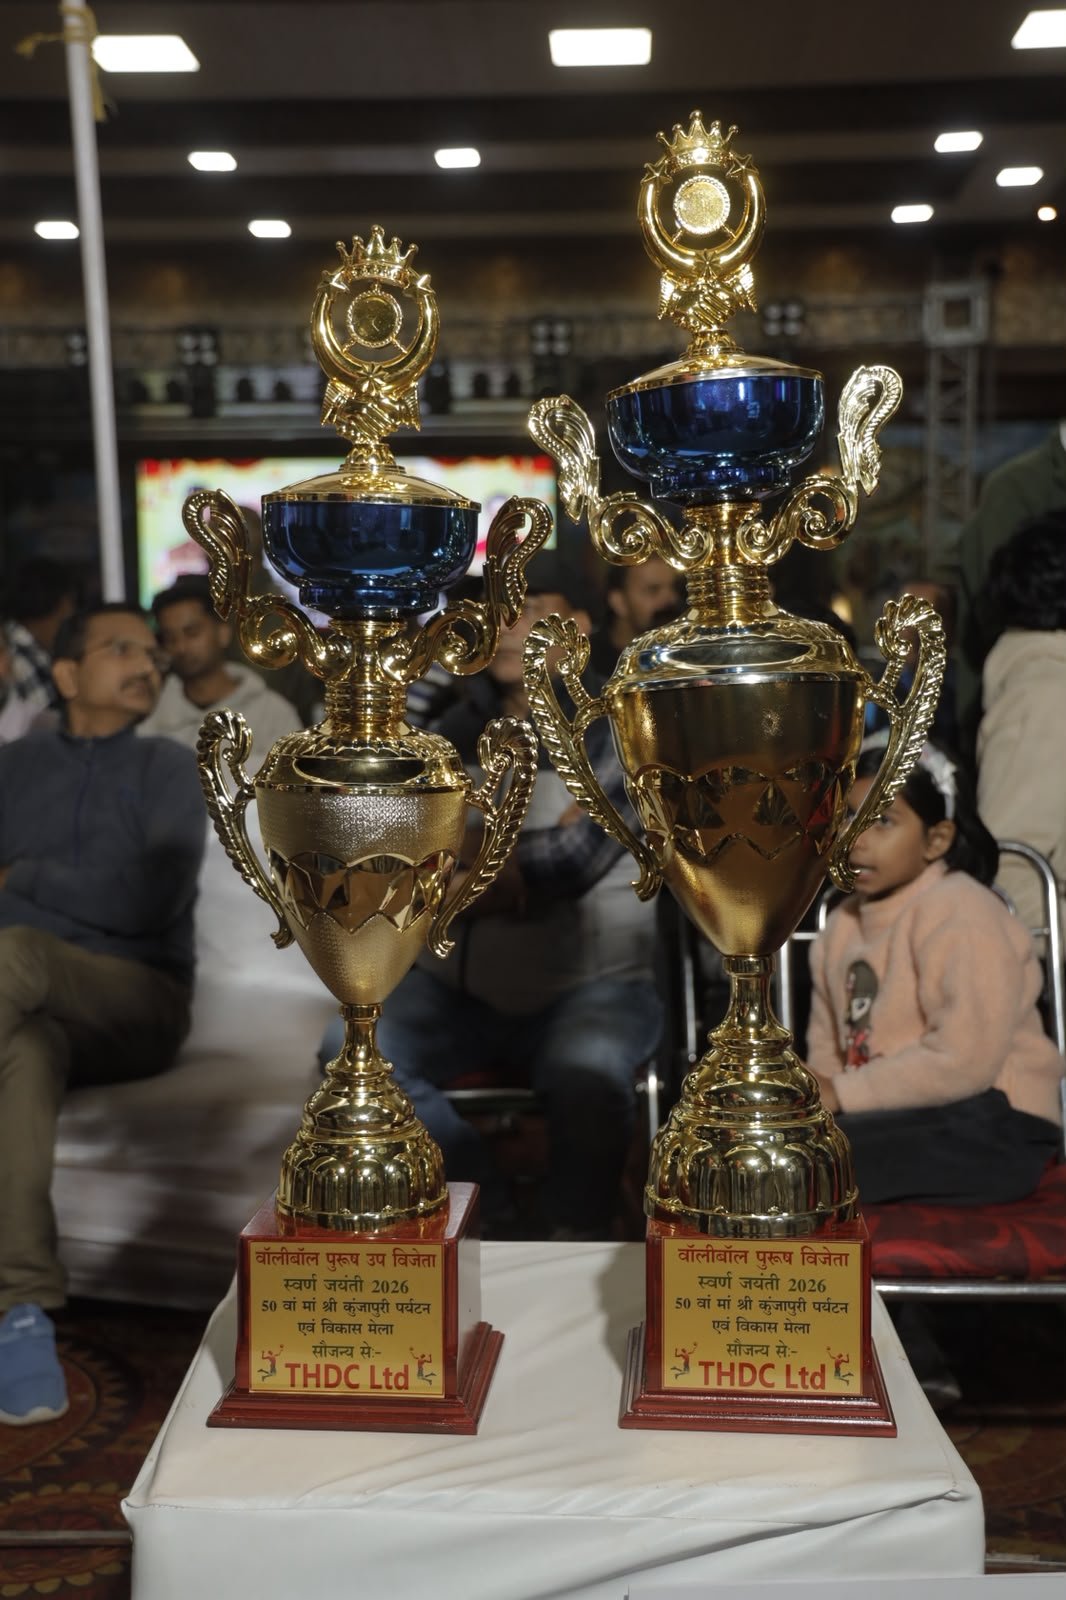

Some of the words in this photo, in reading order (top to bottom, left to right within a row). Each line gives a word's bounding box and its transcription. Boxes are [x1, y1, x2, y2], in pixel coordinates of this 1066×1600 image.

[255, 1248, 319, 1266] वॉलीबॉल
[367, 1253, 386, 1267] उप
[392, 1249, 436, 1268] विजेता
[678, 1245, 749, 1264] वॉलीबॉल
[801, 1246, 849, 1267] विजेता
[284, 1274, 316, 1292] स्वर्ण
[324, 1275, 363, 1292] जयंती
[372, 1280, 409, 1293] 2026
[698, 1272, 731, 1289] स्वर्ण
[739, 1273, 780, 1291] जयंती
[788, 1279, 826, 1292] 2026
[262, 1301, 277, 1311] 50
[283, 1297, 296, 1311] वां
[303, 1298, 316, 1312] मां
[323, 1298, 337, 1312] श्री
[343, 1298, 389, 1317] कुंजापुरी
[396, 1299, 431, 1314] पर्यटन
[675, 1298, 691, 1309] 50
[697, 1295, 711, 1310] वां
[717, 1296, 731, 1310] मां
[737, 1296, 752, 1311] श्री
[759, 1297, 806, 1316] कुंजापुरी
[812, 1297, 849, 1314] पर्यटन
[298, 1318, 315, 1336] एवं
[321, 1318, 362, 1334] विकास
[368, 1319, 393, 1335] मेला
[712, 1316, 730, 1334] एवं
[736, 1317, 778, 1333] विकास
[784, 1318, 810, 1334] मेला
[312, 1341, 354, 1359] सौजन्य
[726, 1339, 769, 1357] सौजन्य
[285, 1363, 359, 1389] THDC
[370, 1365, 408, 1390] Ltd
[698, 1361, 775, 1388] THDC
[786, 1364, 826, 1389] Ltd
